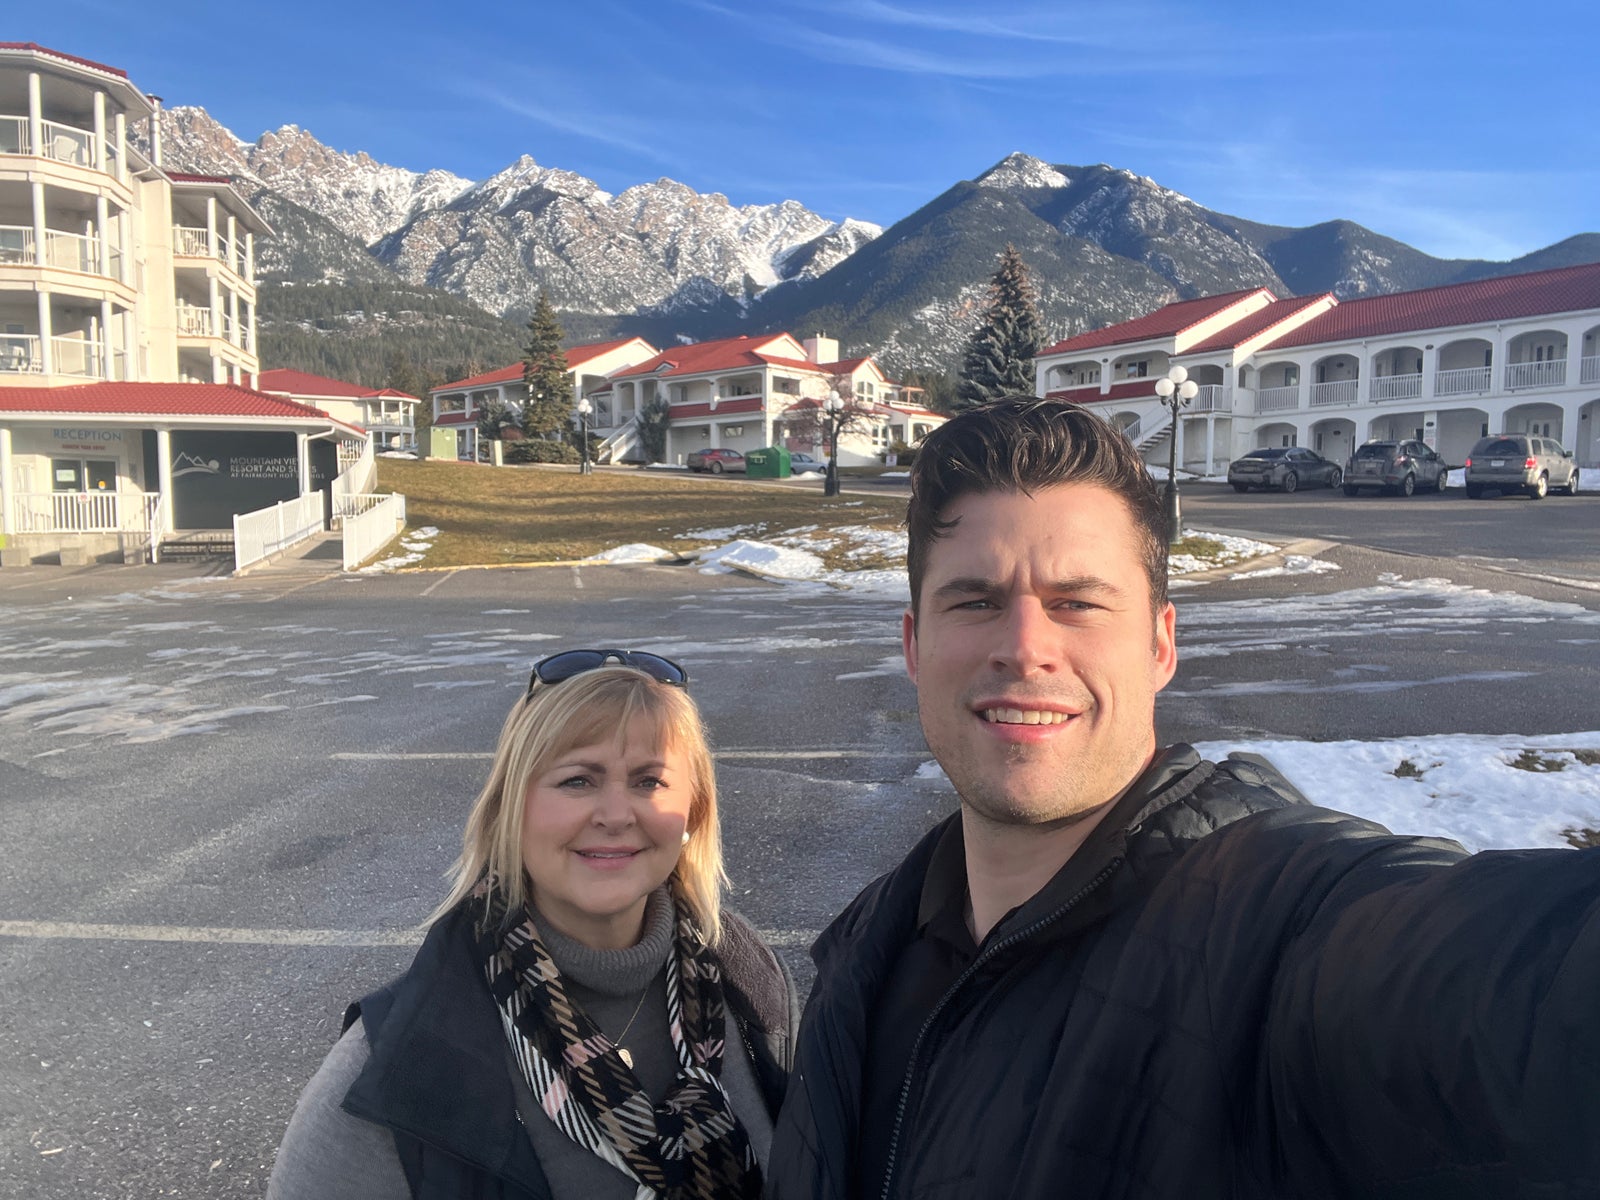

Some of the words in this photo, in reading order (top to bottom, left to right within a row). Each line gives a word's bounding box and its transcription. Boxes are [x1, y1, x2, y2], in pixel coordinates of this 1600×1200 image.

[53, 428, 121, 441] RECEPTION
[230, 457, 281, 465] MOUNTAIN
[283, 458, 299, 466] VIE
[230, 465, 263, 473] RESORT
[265, 465, 286, 473] AND
[288, 465, 317, 474] SUS
